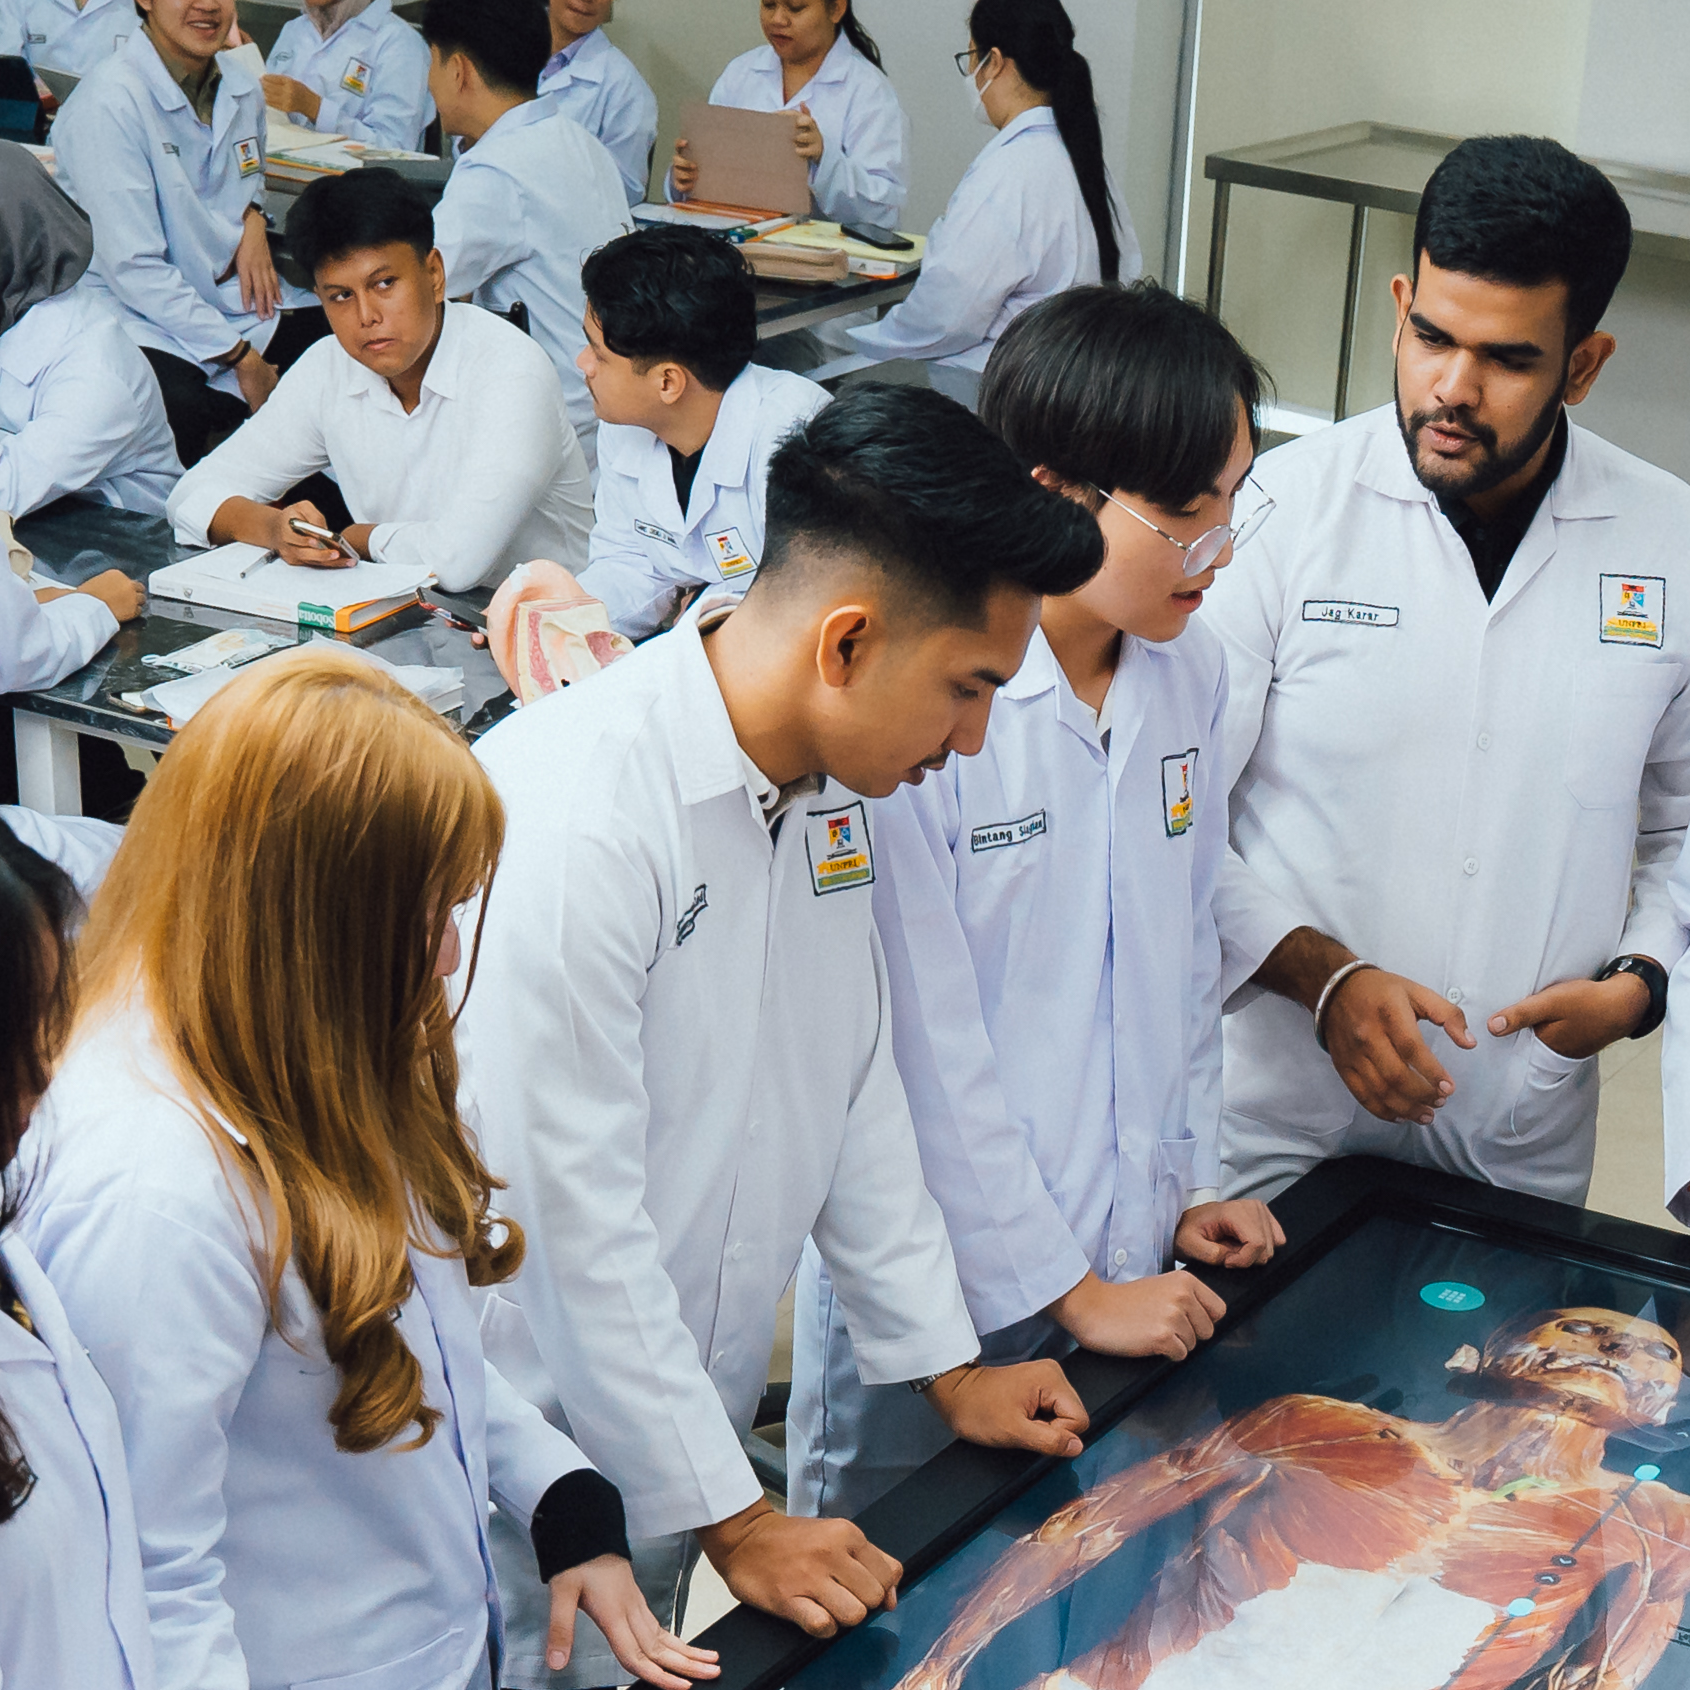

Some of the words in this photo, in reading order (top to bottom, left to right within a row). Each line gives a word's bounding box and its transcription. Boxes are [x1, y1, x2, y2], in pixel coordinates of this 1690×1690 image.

[1322, 606, 1342, 620] Jag
[973, 830, 1012, 846] Bintang
[829, 858, 860, 872] UNPRI
